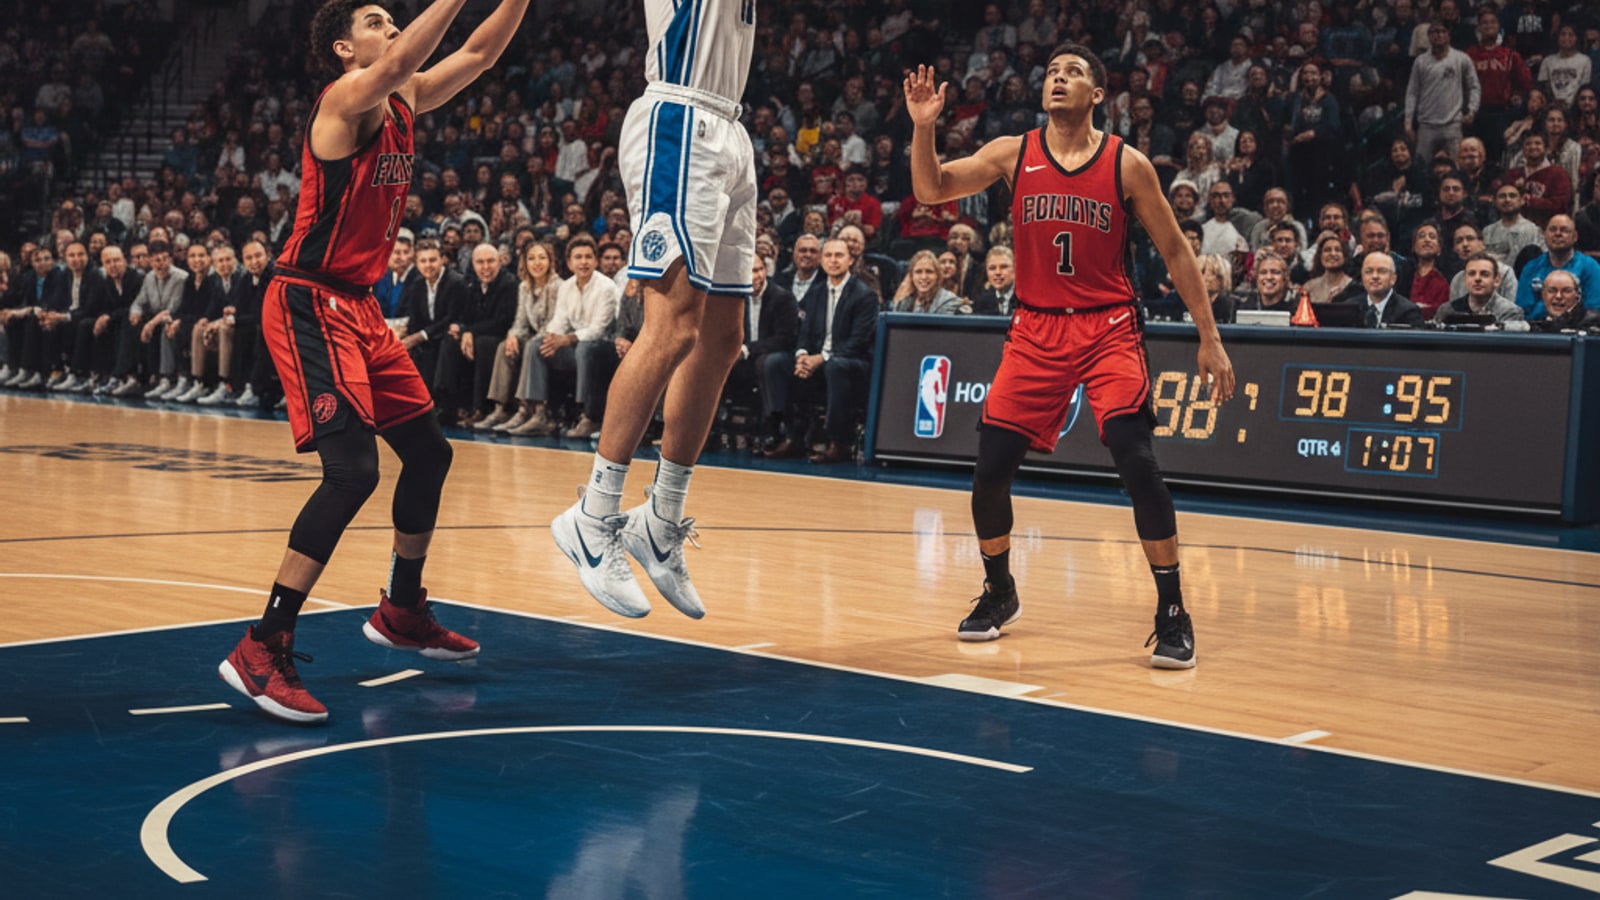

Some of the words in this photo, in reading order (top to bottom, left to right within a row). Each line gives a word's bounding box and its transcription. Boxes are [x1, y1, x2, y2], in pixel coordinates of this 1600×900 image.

[1053, 232, 1074, 275] 1
[954, 381, 992, 404] HO
[1295, 371, 1351, 417] 98
[1297, 438, 1329, 457] QTR
[1362, 435, 1434, 471] 1:07
